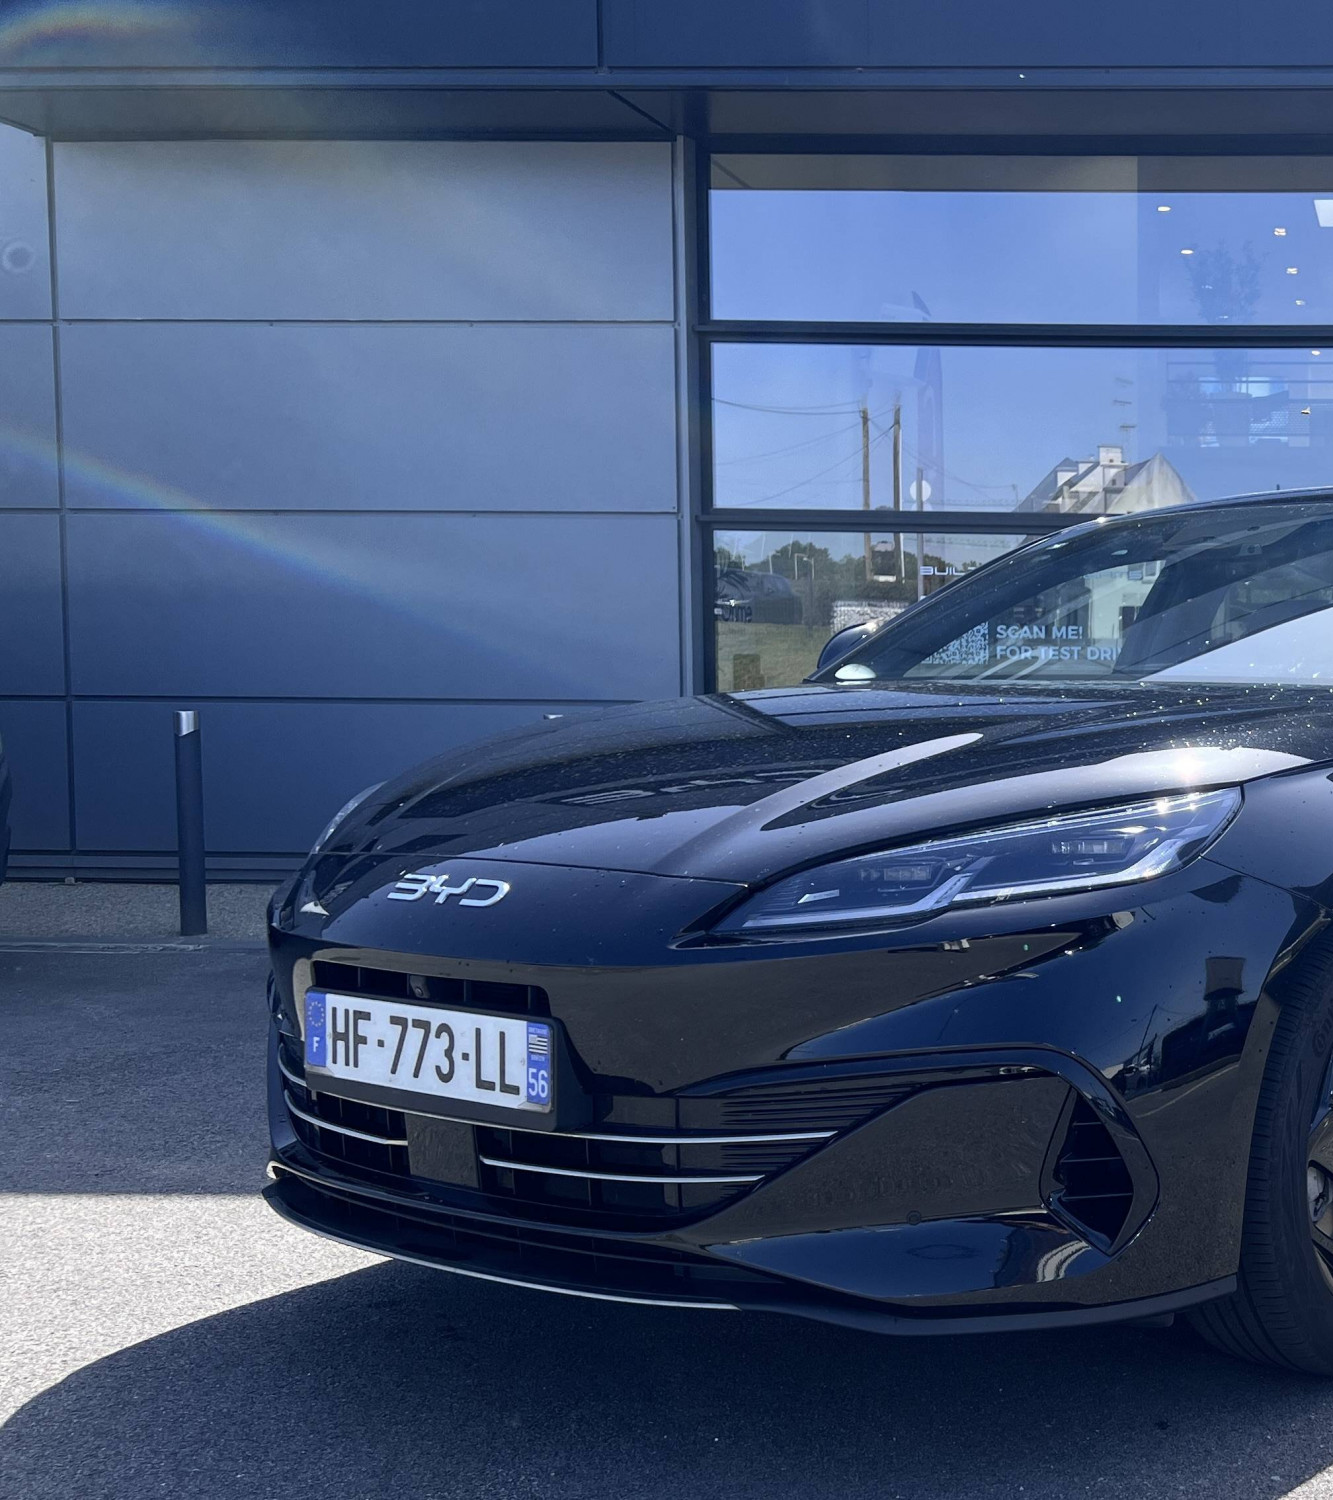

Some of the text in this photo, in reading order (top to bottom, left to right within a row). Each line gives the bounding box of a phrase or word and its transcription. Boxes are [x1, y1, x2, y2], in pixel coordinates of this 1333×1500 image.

[996, 624, 1083, 640] SCAN ME!
[996, 645, 1122, 661] FOR TEST DRI
[386, 872, 511, 908] BYD
[312, 1036, 320, 1053] F
[330, 1006, 520, 1096] HF-773-LL
[528, 1068, 548, 1098] 56
